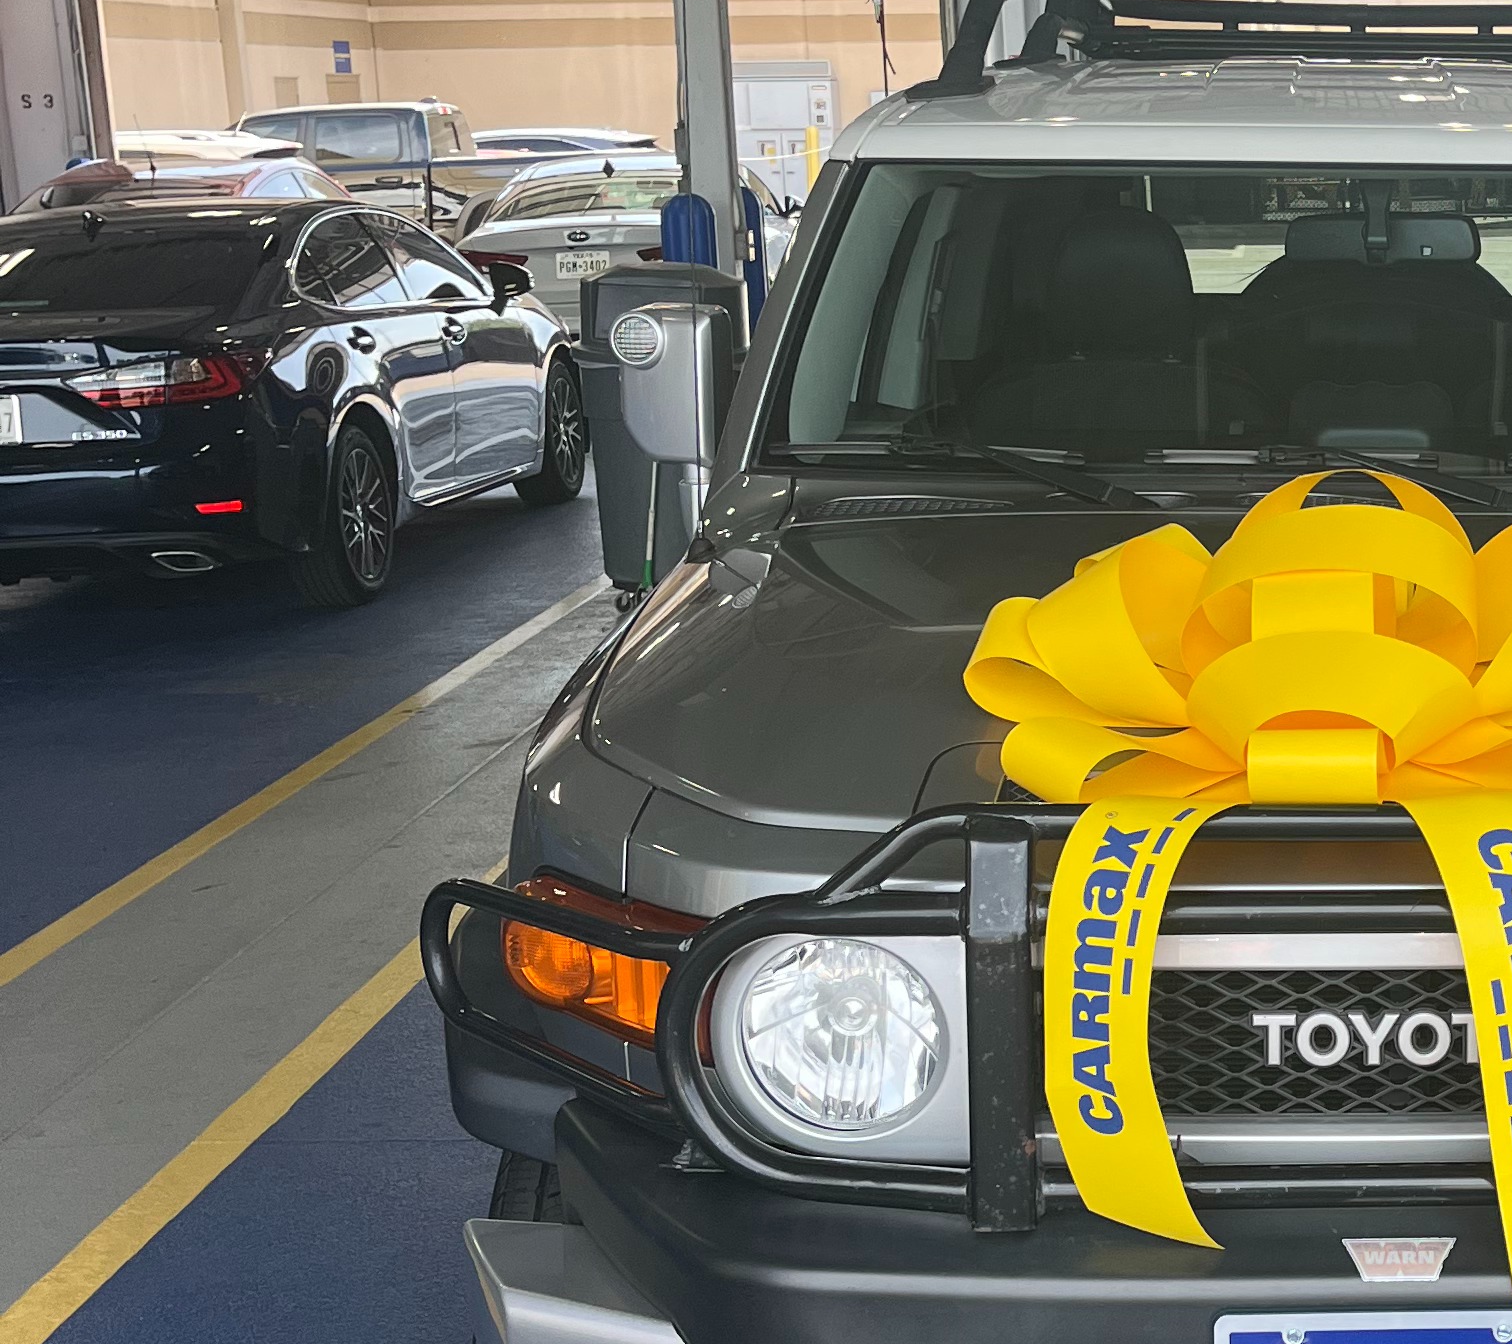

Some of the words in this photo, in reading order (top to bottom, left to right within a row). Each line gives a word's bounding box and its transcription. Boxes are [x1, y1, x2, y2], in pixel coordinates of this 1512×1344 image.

[21, 94, 32, 109] S
[43, 94, 54, 109] 3
[1252, 1012, 1479, 1067] TOYOT
[1363, 1250, 1435, 1265] WARN
